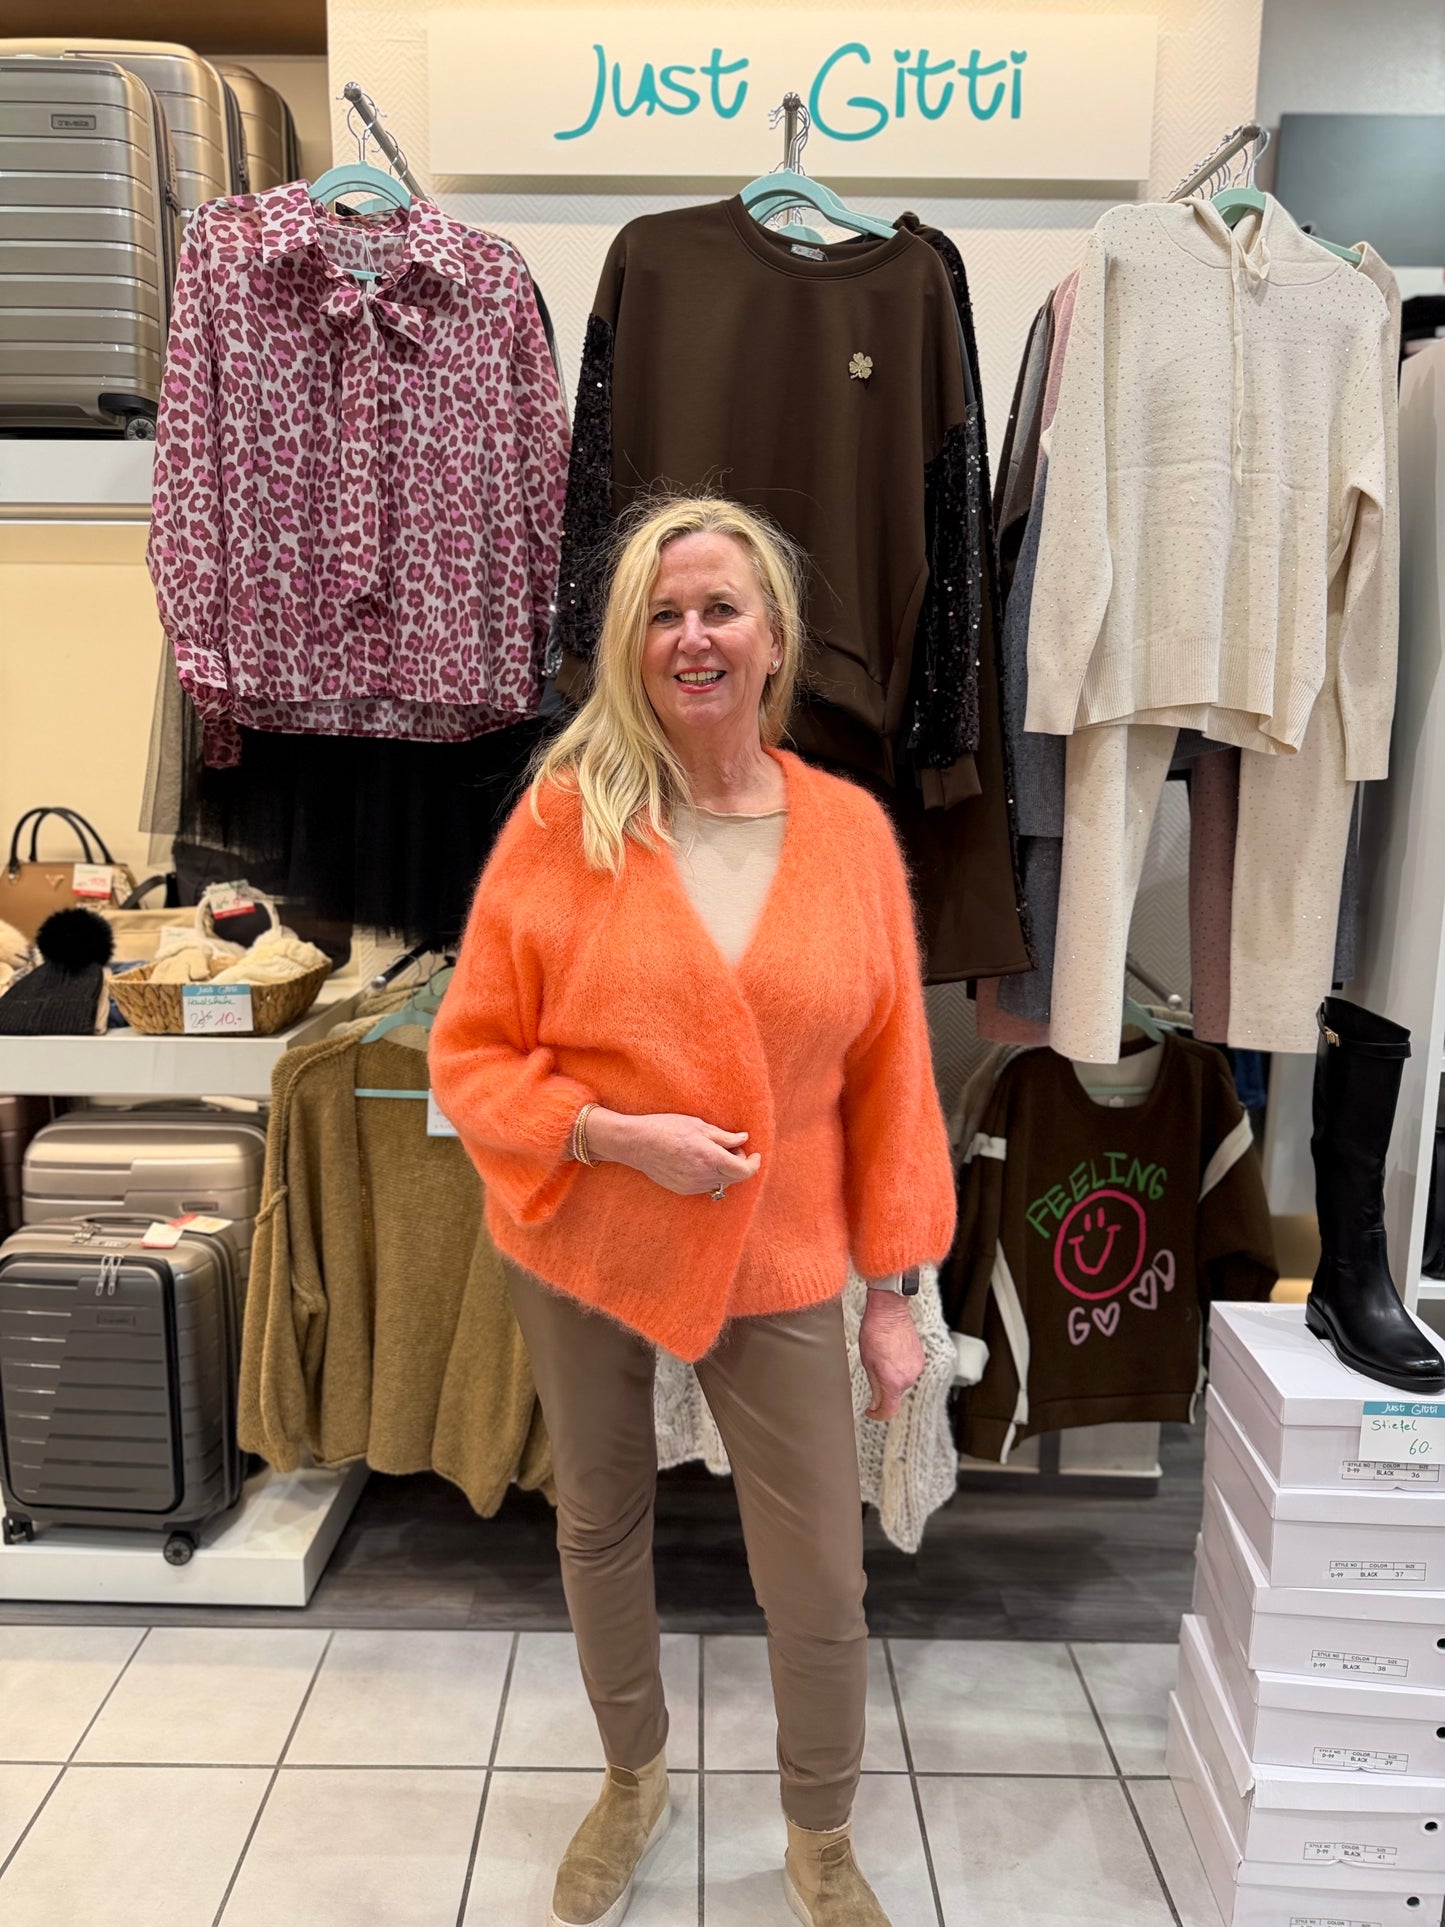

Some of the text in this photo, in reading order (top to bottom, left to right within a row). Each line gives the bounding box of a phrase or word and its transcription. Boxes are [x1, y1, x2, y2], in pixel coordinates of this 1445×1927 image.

[553, 42, 1027, 141] Just Gitti
[1026, 1152, 1167, 1239] FEELING
[1371, 1420, 1418, 1432] Stiefel
[1381, 1403, 1438, 1415] Just Gitti
